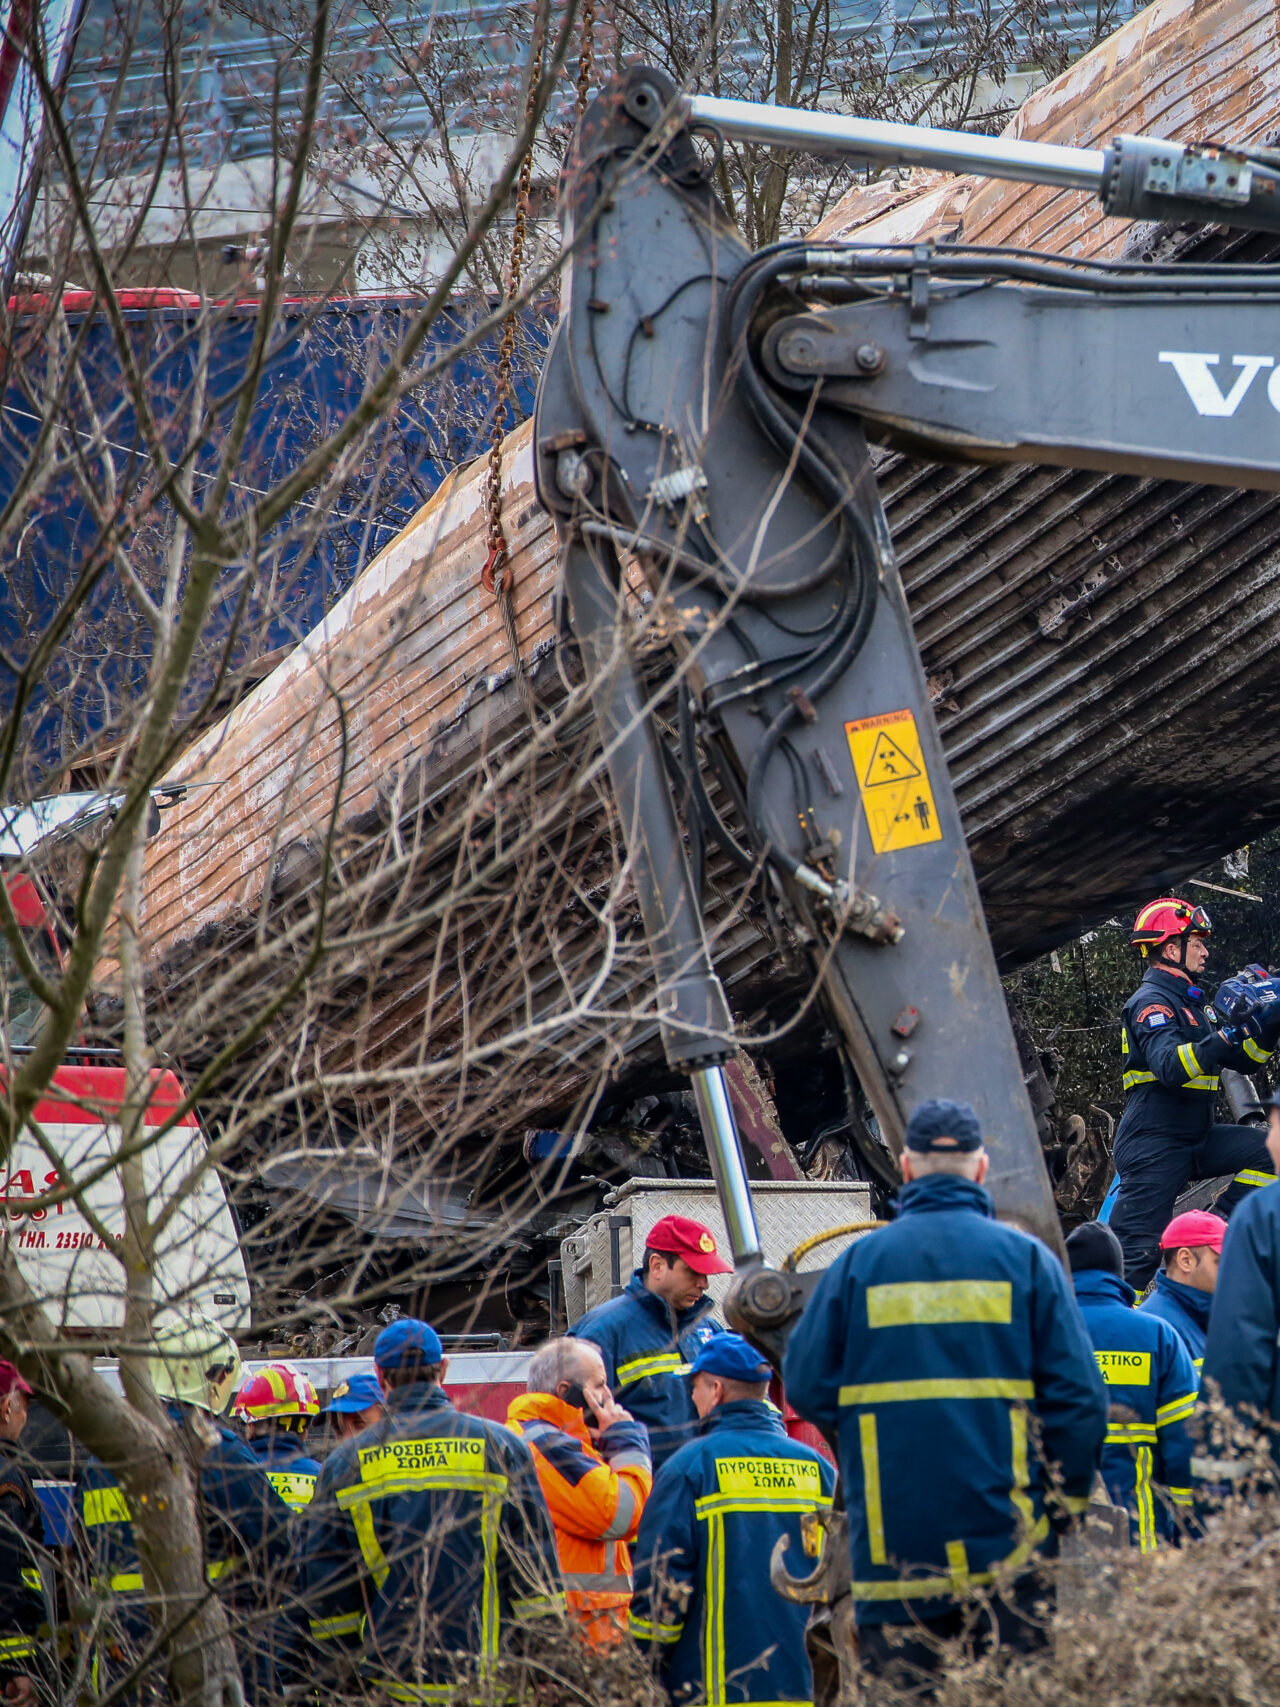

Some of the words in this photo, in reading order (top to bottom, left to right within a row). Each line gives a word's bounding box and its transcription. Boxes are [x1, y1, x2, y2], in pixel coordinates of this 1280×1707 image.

[861, 714, 908, 730] WARNING
[55, 1232, 93, 1249] 23510
[363, 1441, 481, 1464] ΠΥΡΟΣΒΕΣΤΙΚΟ
[398, 1455, 448, 1468] ΣΩΜΑ
[719, 1461, 817, 1477] ΠΥΡΟΣΒΕΣΤΙΚΟ
[753, 1476, 795, 1488] ΣΩΜΑ
